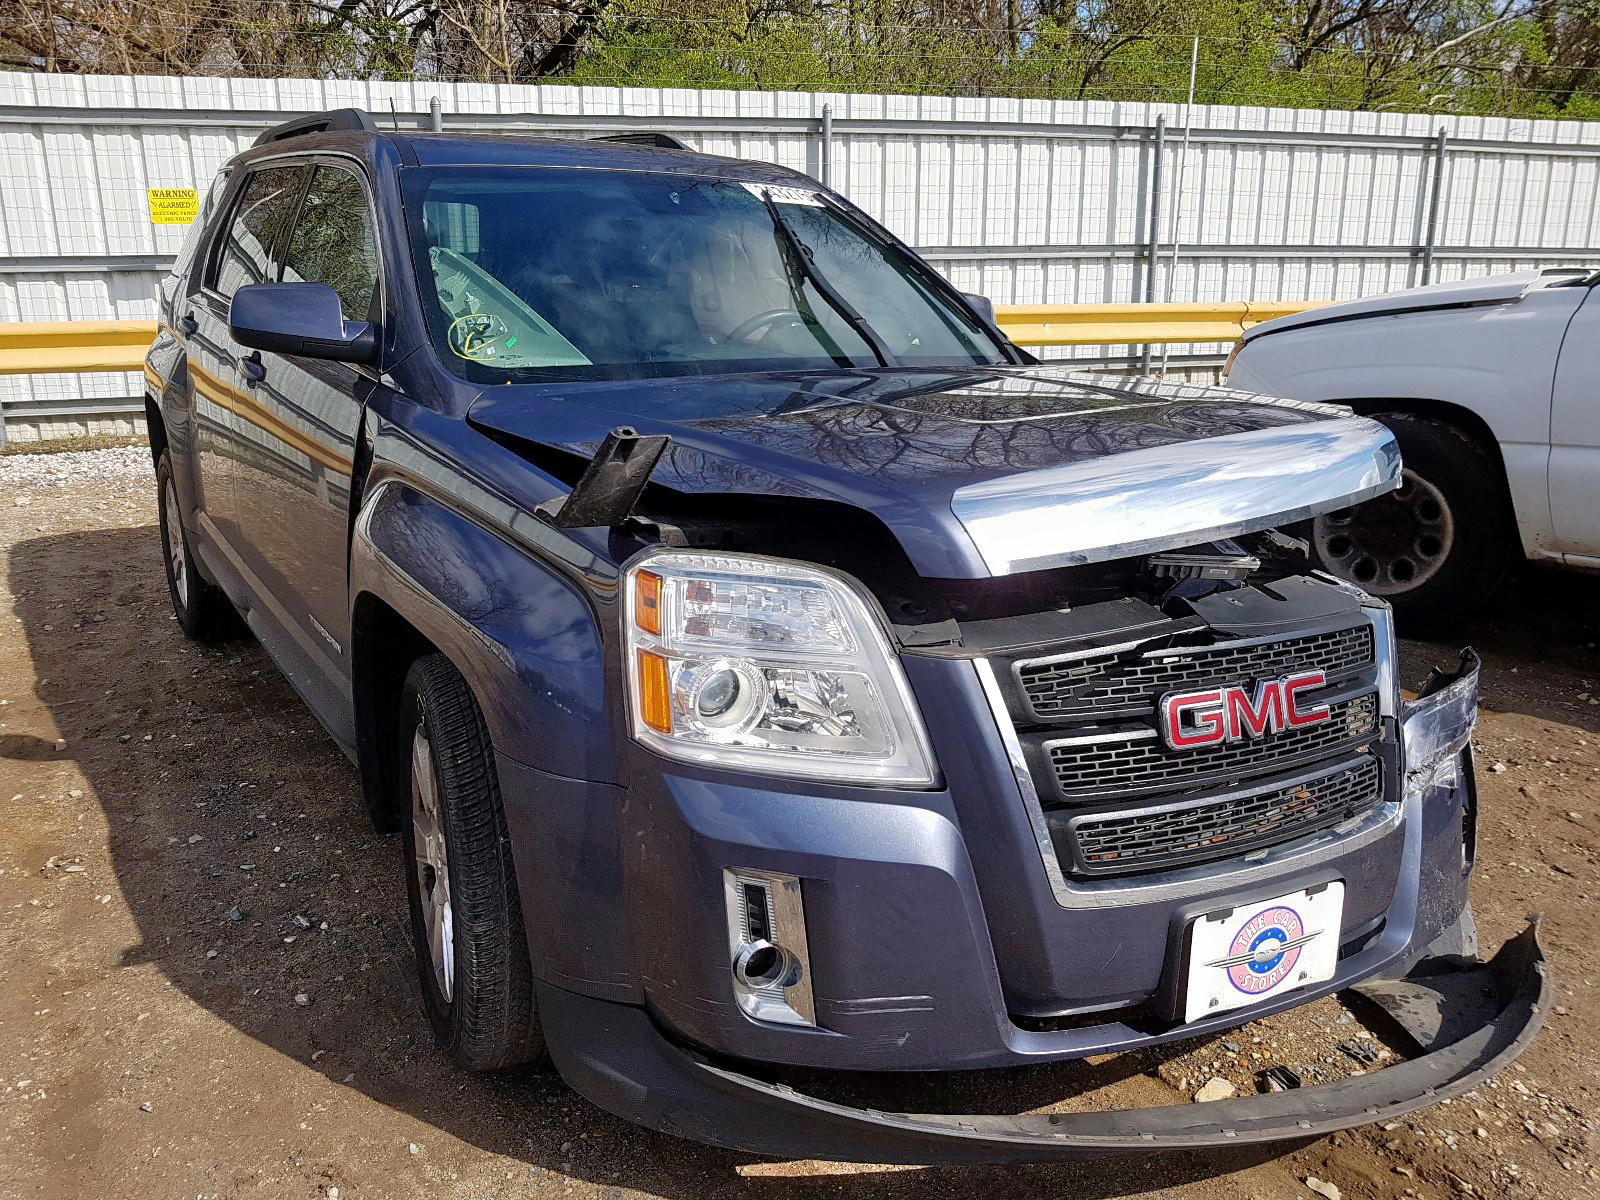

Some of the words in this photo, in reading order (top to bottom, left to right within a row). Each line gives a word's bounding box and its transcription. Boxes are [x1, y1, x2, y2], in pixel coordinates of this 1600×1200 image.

[151, 190, 194, 198] WARNING
[158, 201, 191, 209] ALARMED
[1159, 669, 1331, 751] GMC
[1236, 914, 1266, 947] THE
[1272, 910, 1298, 936] CAR
[1240, 964, 1288, 991] STORE
